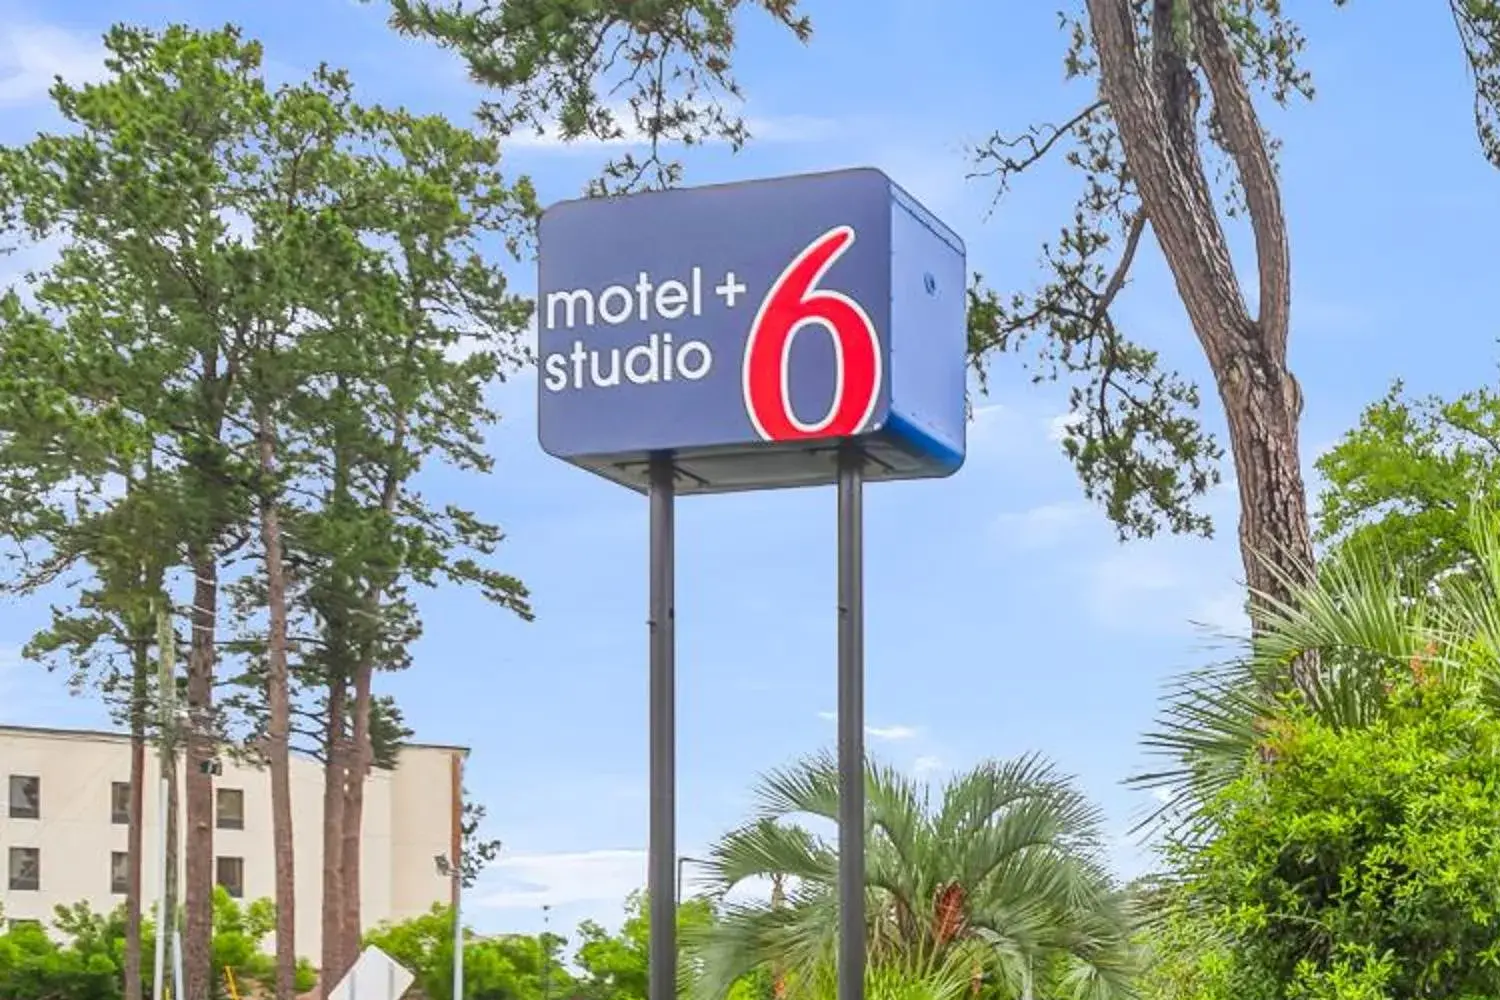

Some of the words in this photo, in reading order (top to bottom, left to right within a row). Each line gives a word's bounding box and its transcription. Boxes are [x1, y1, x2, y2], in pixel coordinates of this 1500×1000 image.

[546, 267, 702, 329] motel
[544, 332, 713, 392] studio
[742, 224, 882, 441] 6
